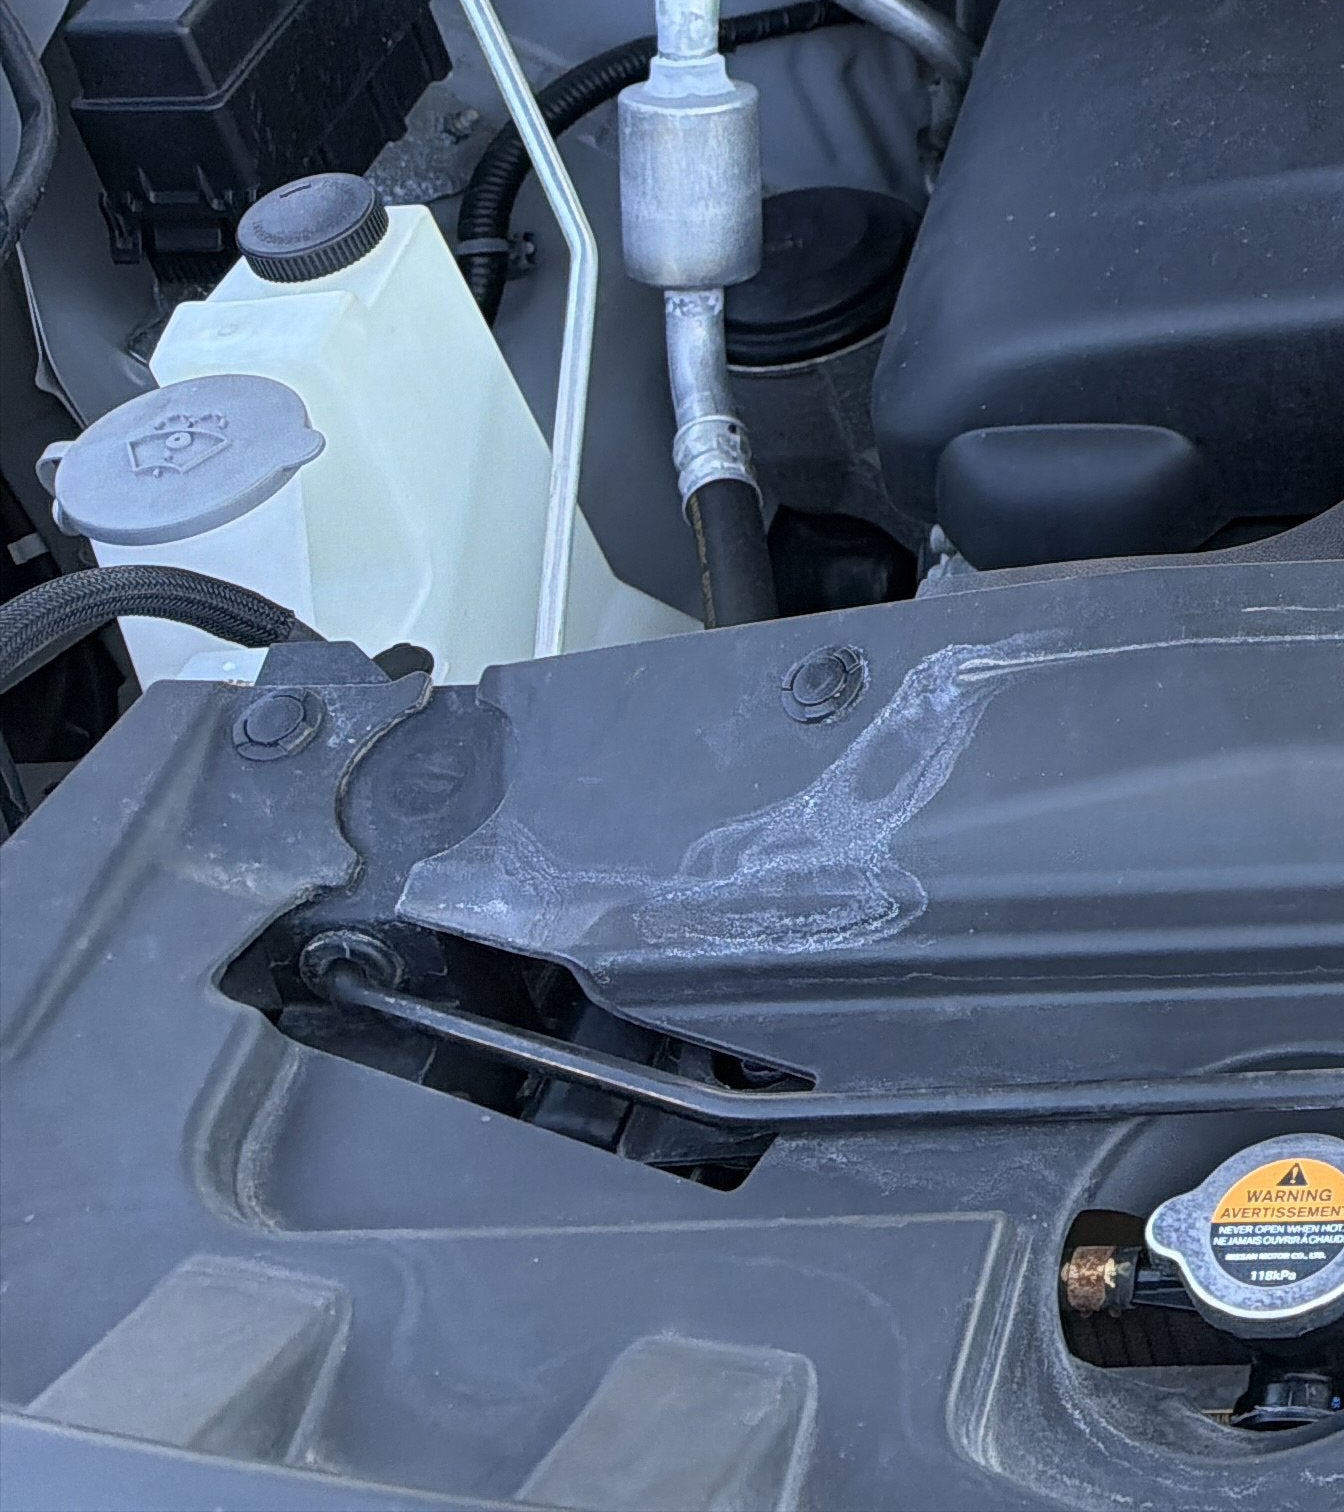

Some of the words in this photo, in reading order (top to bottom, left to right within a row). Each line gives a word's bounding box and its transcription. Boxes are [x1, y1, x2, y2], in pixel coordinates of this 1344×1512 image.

[1246, 1188, 1333, 1203] WARNING
[1218, 1225, 1254, 1235] NEVER
[1256, 1224, 1285, 1234] OPEN
[1285, 1223, 1320, 1234] WHEN
[1321, 1223, 1344, 1233] HOT.
[1250, 1269, 1297, 1281] 118kPa
